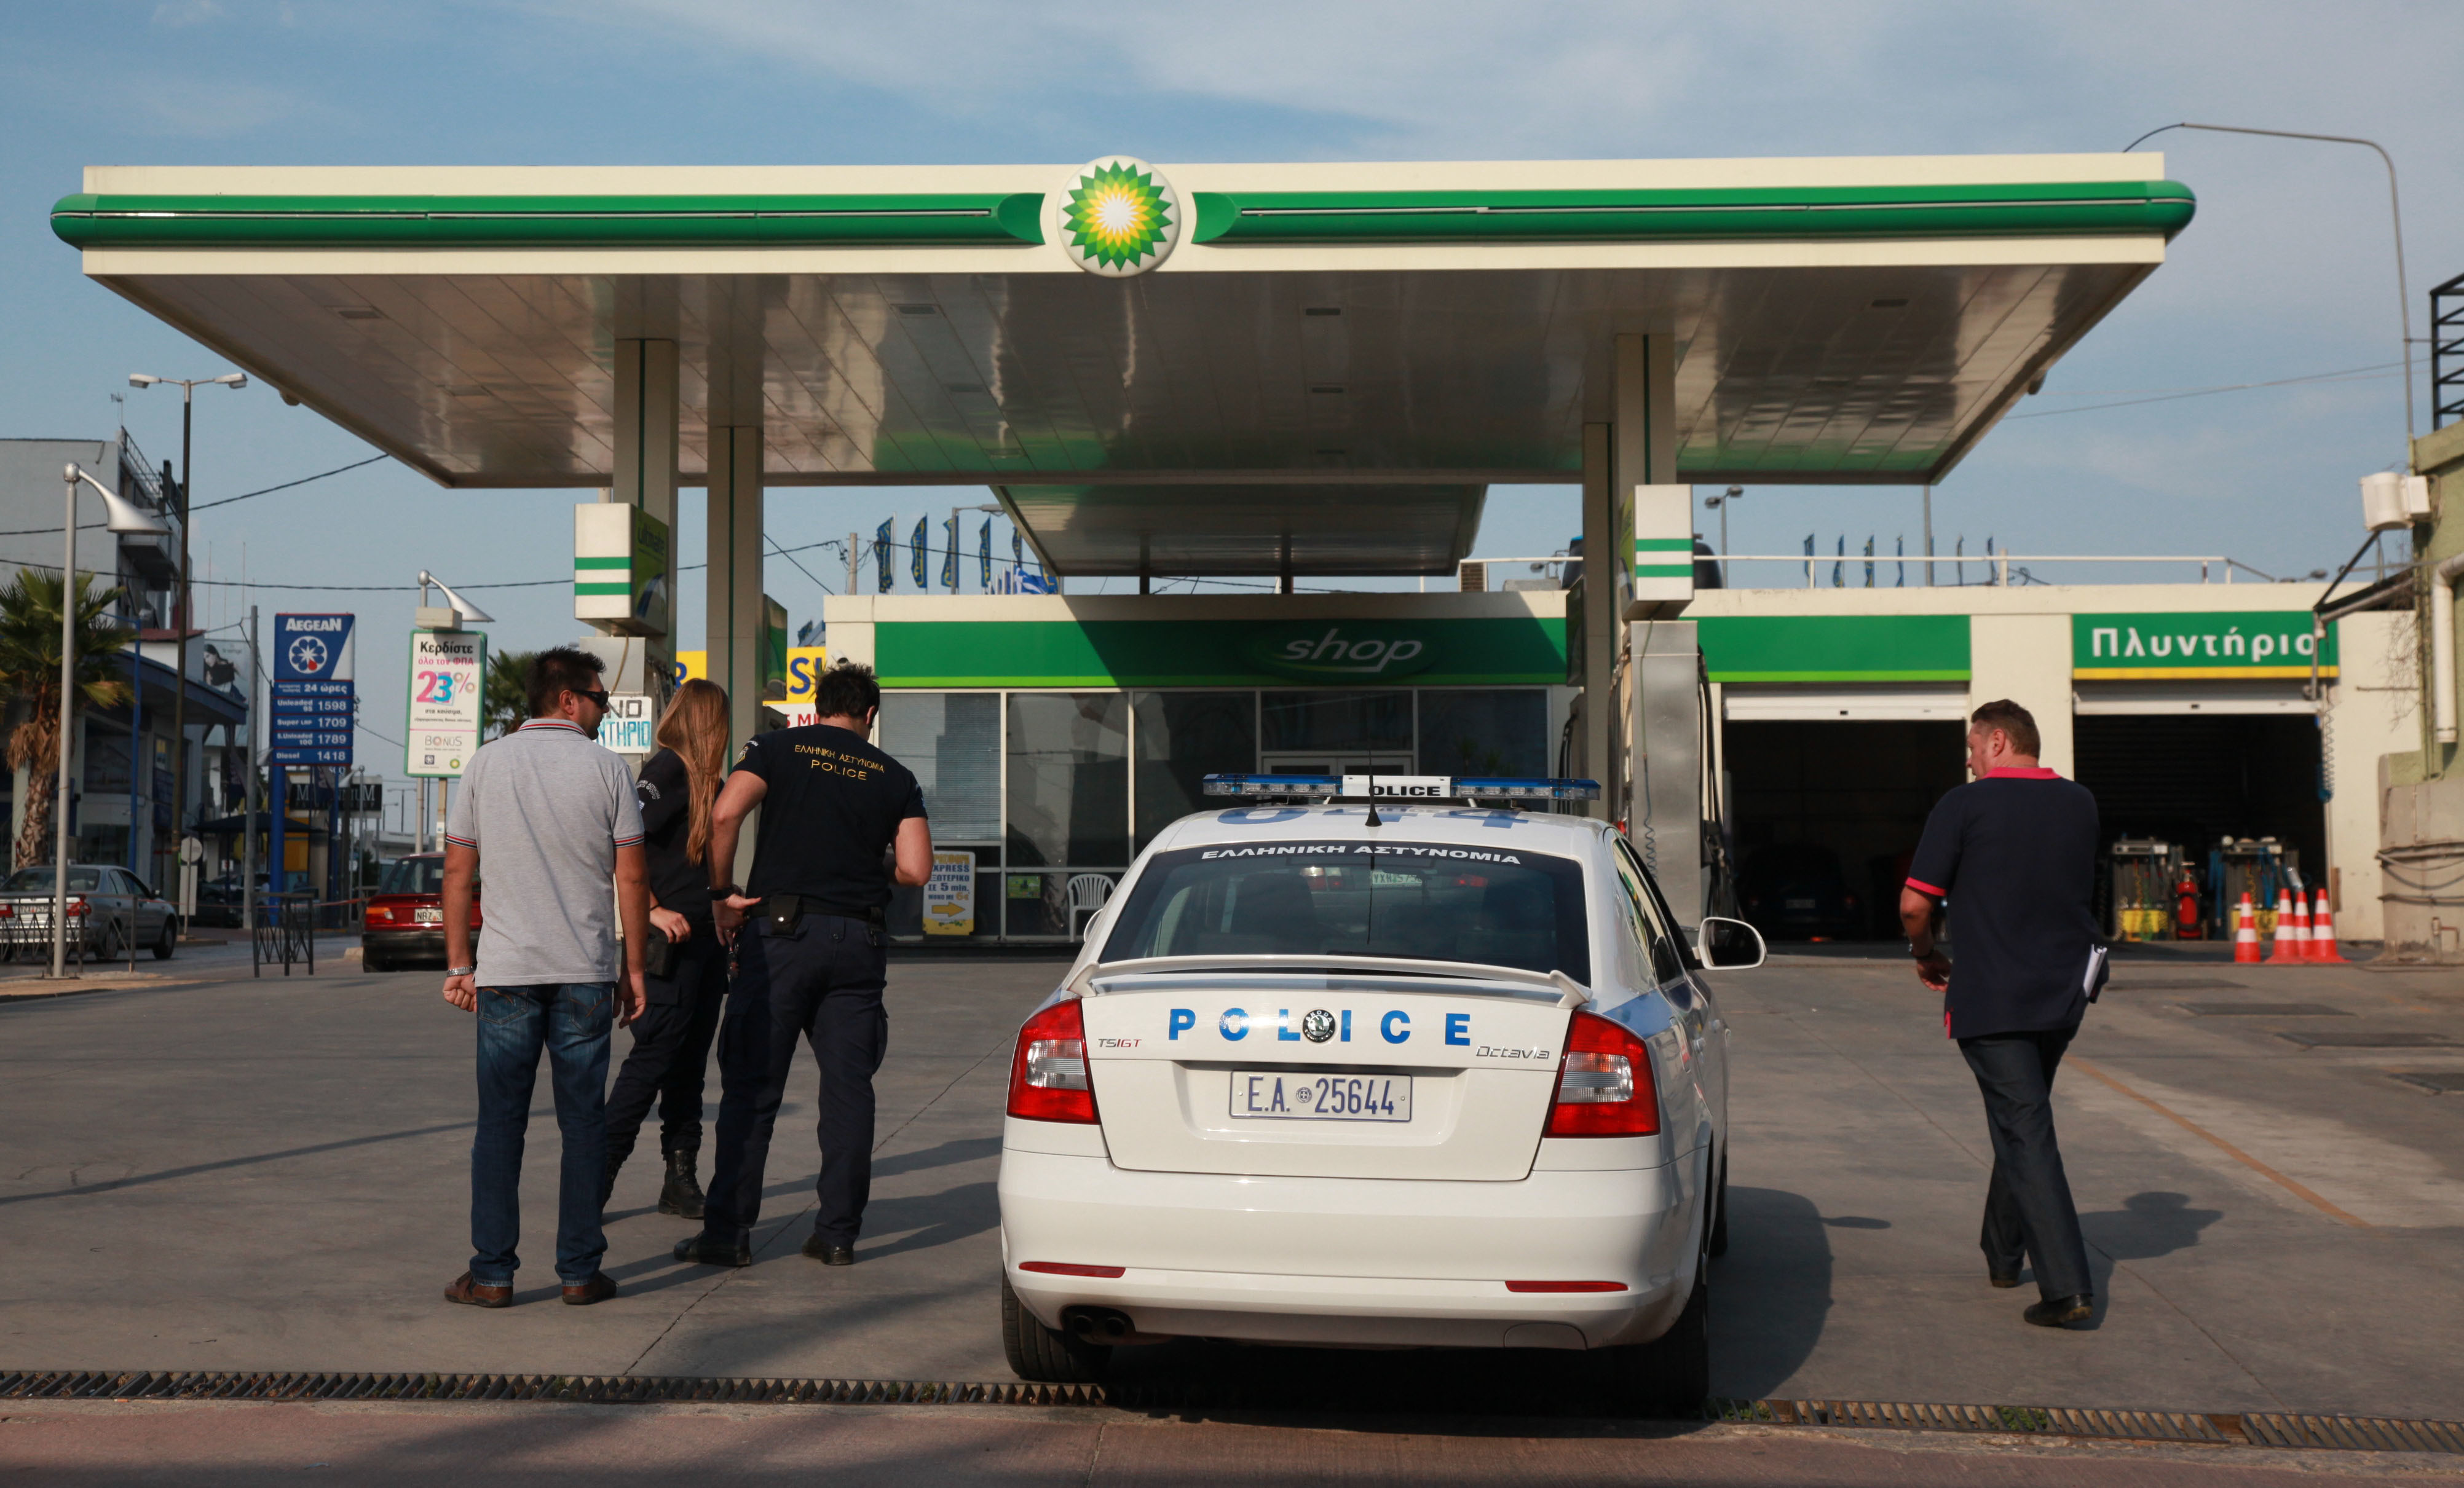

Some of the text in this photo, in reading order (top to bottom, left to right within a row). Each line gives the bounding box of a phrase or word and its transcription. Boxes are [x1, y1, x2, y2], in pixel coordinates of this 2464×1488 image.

[285, 618, 342, 631] AEGEAN
[420, 641, 473, 656] Κερδίστε
[1285, 628, 1423, 672] shop
[2091, 627, 2315, 663] Πλυντήριο
[320, 683, 347, 694] ώρες
[318, 701, 346, 711] 1598
[318, 718, 347, 727] 1709
[318, 734, 346, 744] 1789
[596, 722, 650, 746] ΝΤΗΡΙΟ
[317, 751, 346, 761] 1418
[795, 744, 885, 773] ΕΛΛΗΝΙΚΗ ΑΣΤΥΝΟΜΙΑ
[811, 759, 867, 781] POLICE
[1201, 846, 1521, 865] ΕΛΛΗΝΙΚΗ ΑΣΤΥΝΟΜΙΑ
[1169, 1008, 1471, 1046] POLICE
[1475, 1045, 1550, 1059] Octavia
[1315, 1077, 1394, 1115] 25644
